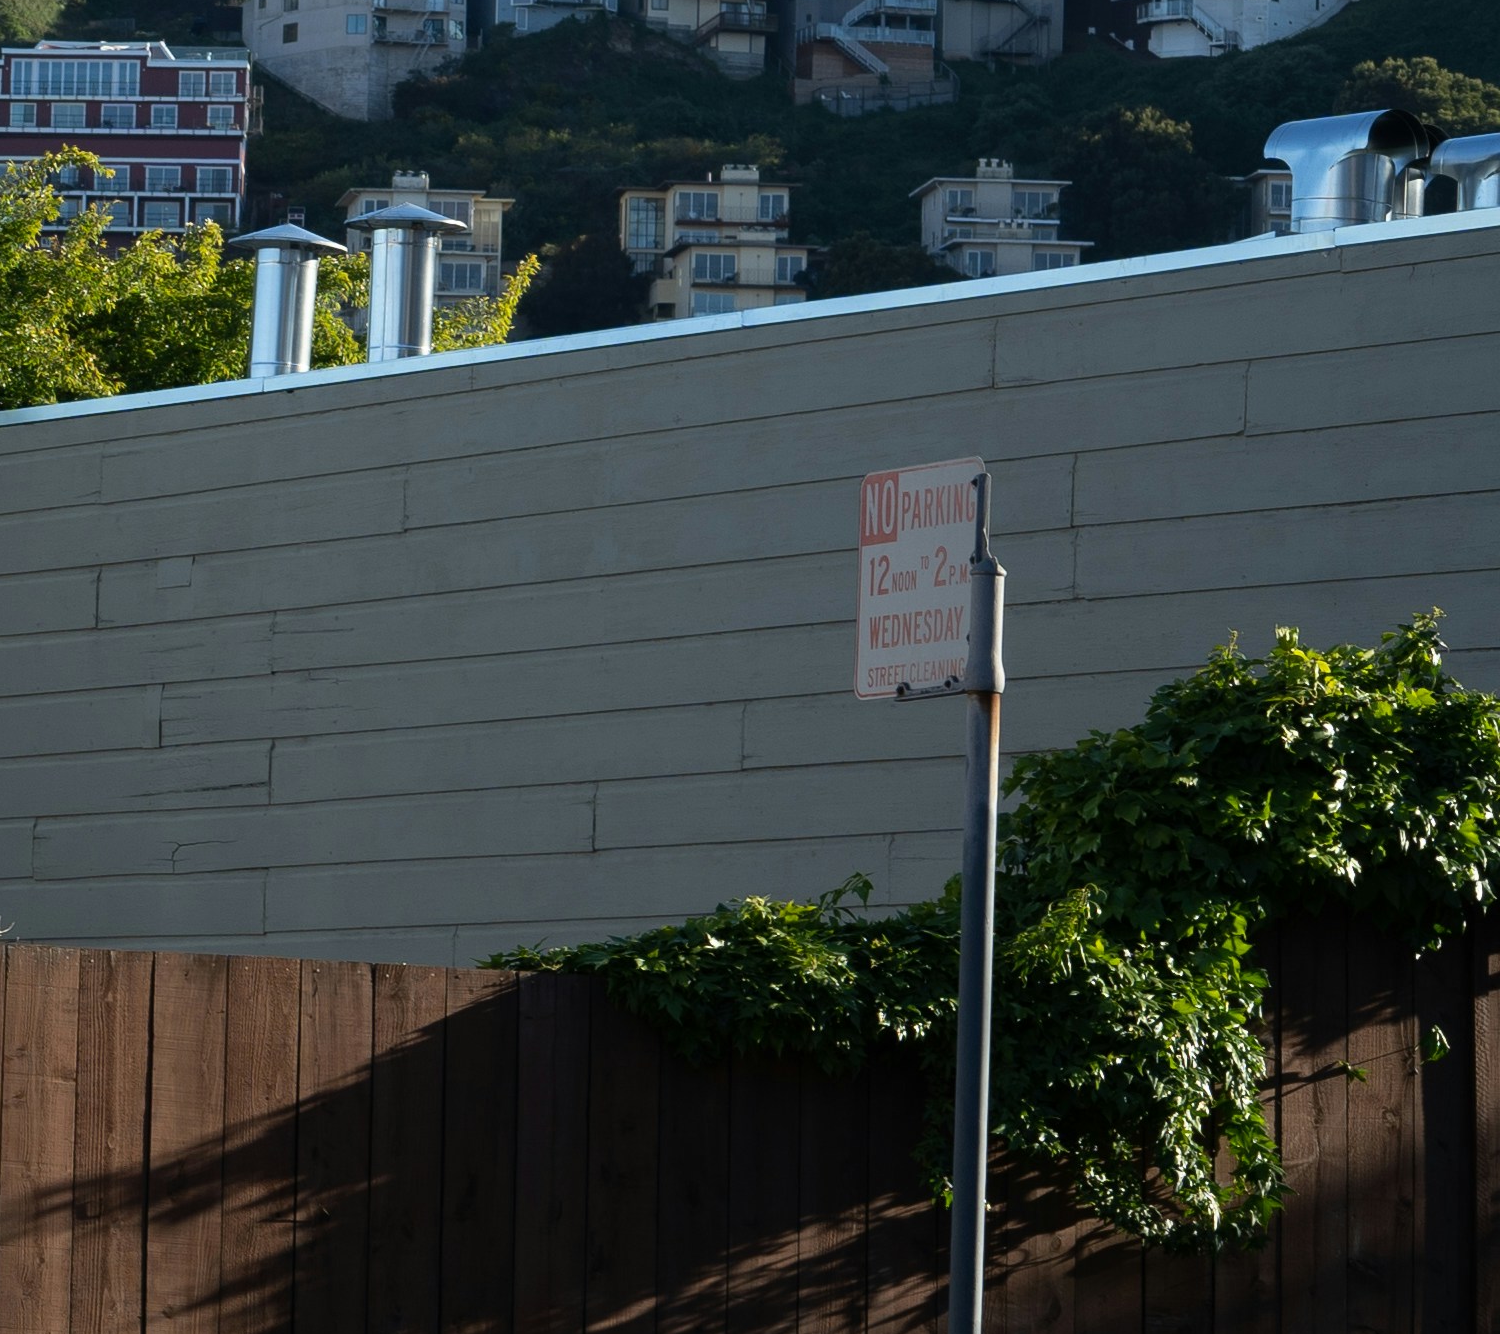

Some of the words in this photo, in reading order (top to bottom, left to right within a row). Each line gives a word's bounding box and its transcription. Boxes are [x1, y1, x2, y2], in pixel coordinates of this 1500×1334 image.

[866, 479, 897, 537] NO
[901, 482, 976, 531] PARKING
[870, 554, 891, 597] 12
[892, 570, 917, 593] NOON
[920, 555, 930, 570] TO
[934, 546, 948, 587] 2
[949, 564, 971, 586] P.M.
[869, 606, 965, 650] WEDNESDAY
[867, 663, 907, 688] STREET
[910, 658, 966, 684] CLEANING
